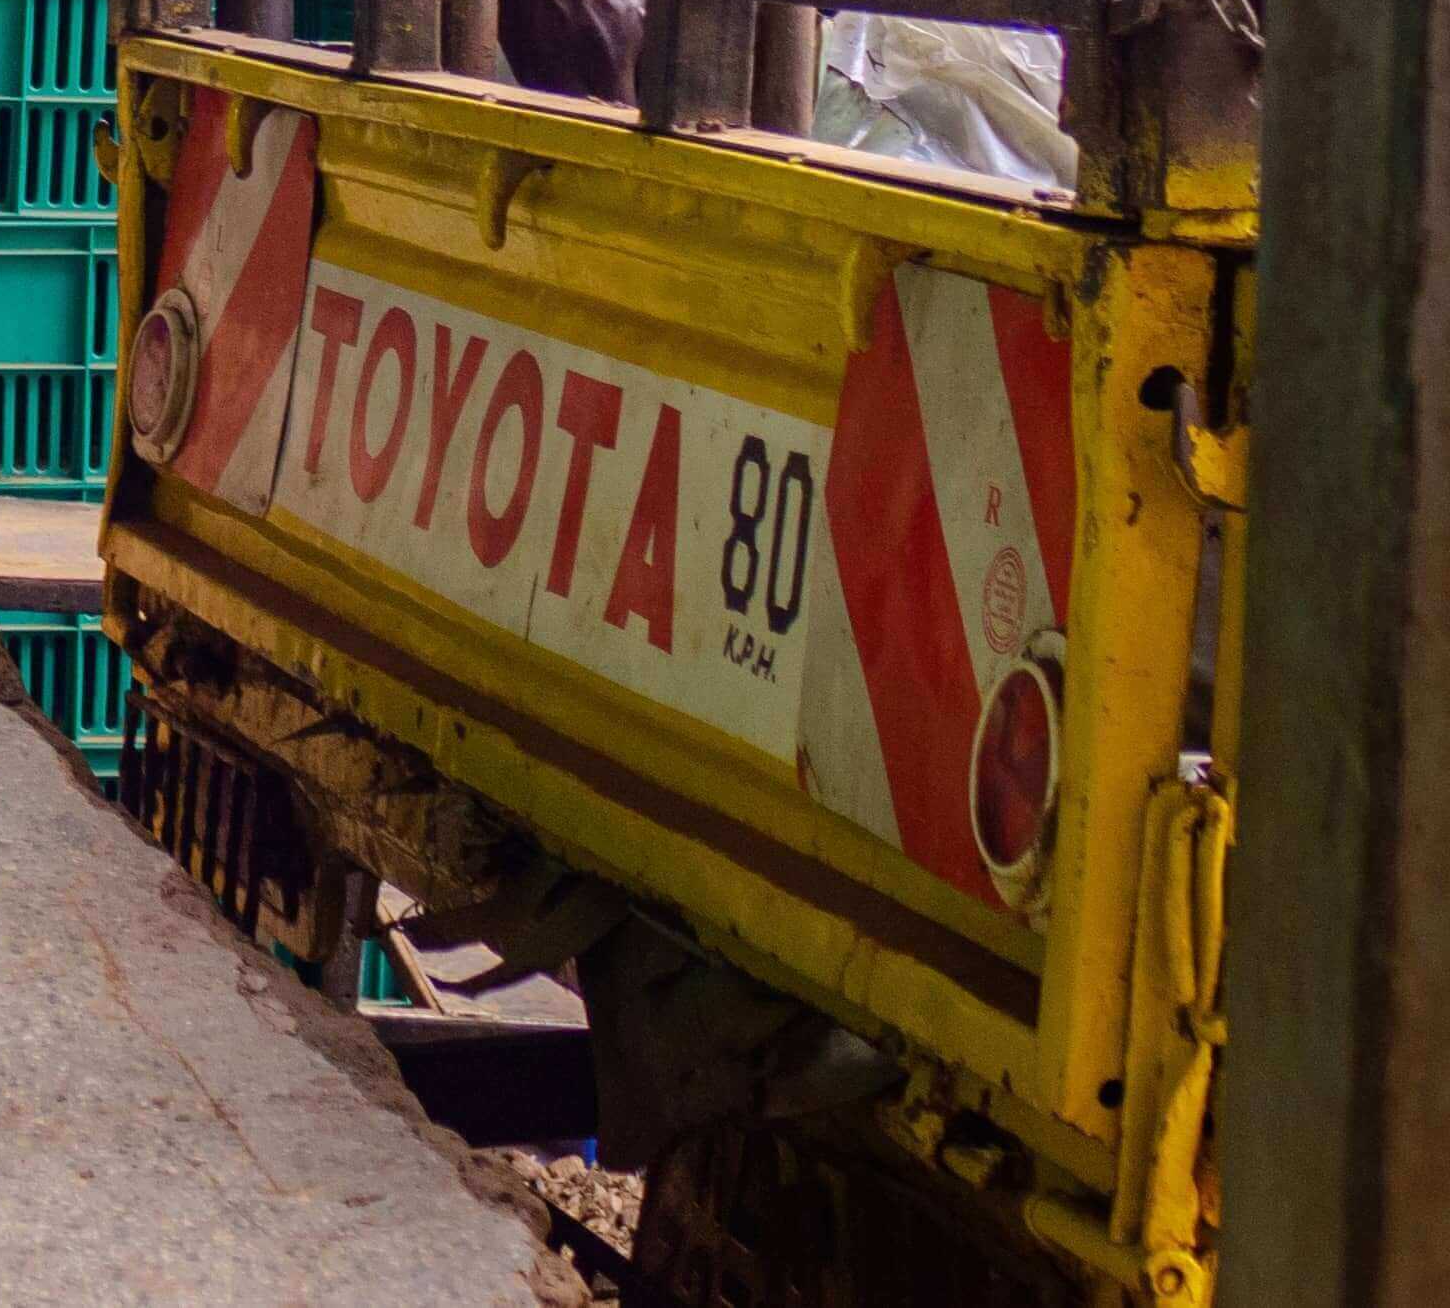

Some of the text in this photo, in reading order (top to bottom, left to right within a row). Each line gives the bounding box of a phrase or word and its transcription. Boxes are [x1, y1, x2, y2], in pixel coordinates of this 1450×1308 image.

[304, 286, 813, 655] TOYOTA 80
[984, 485, 1002, 527] R
